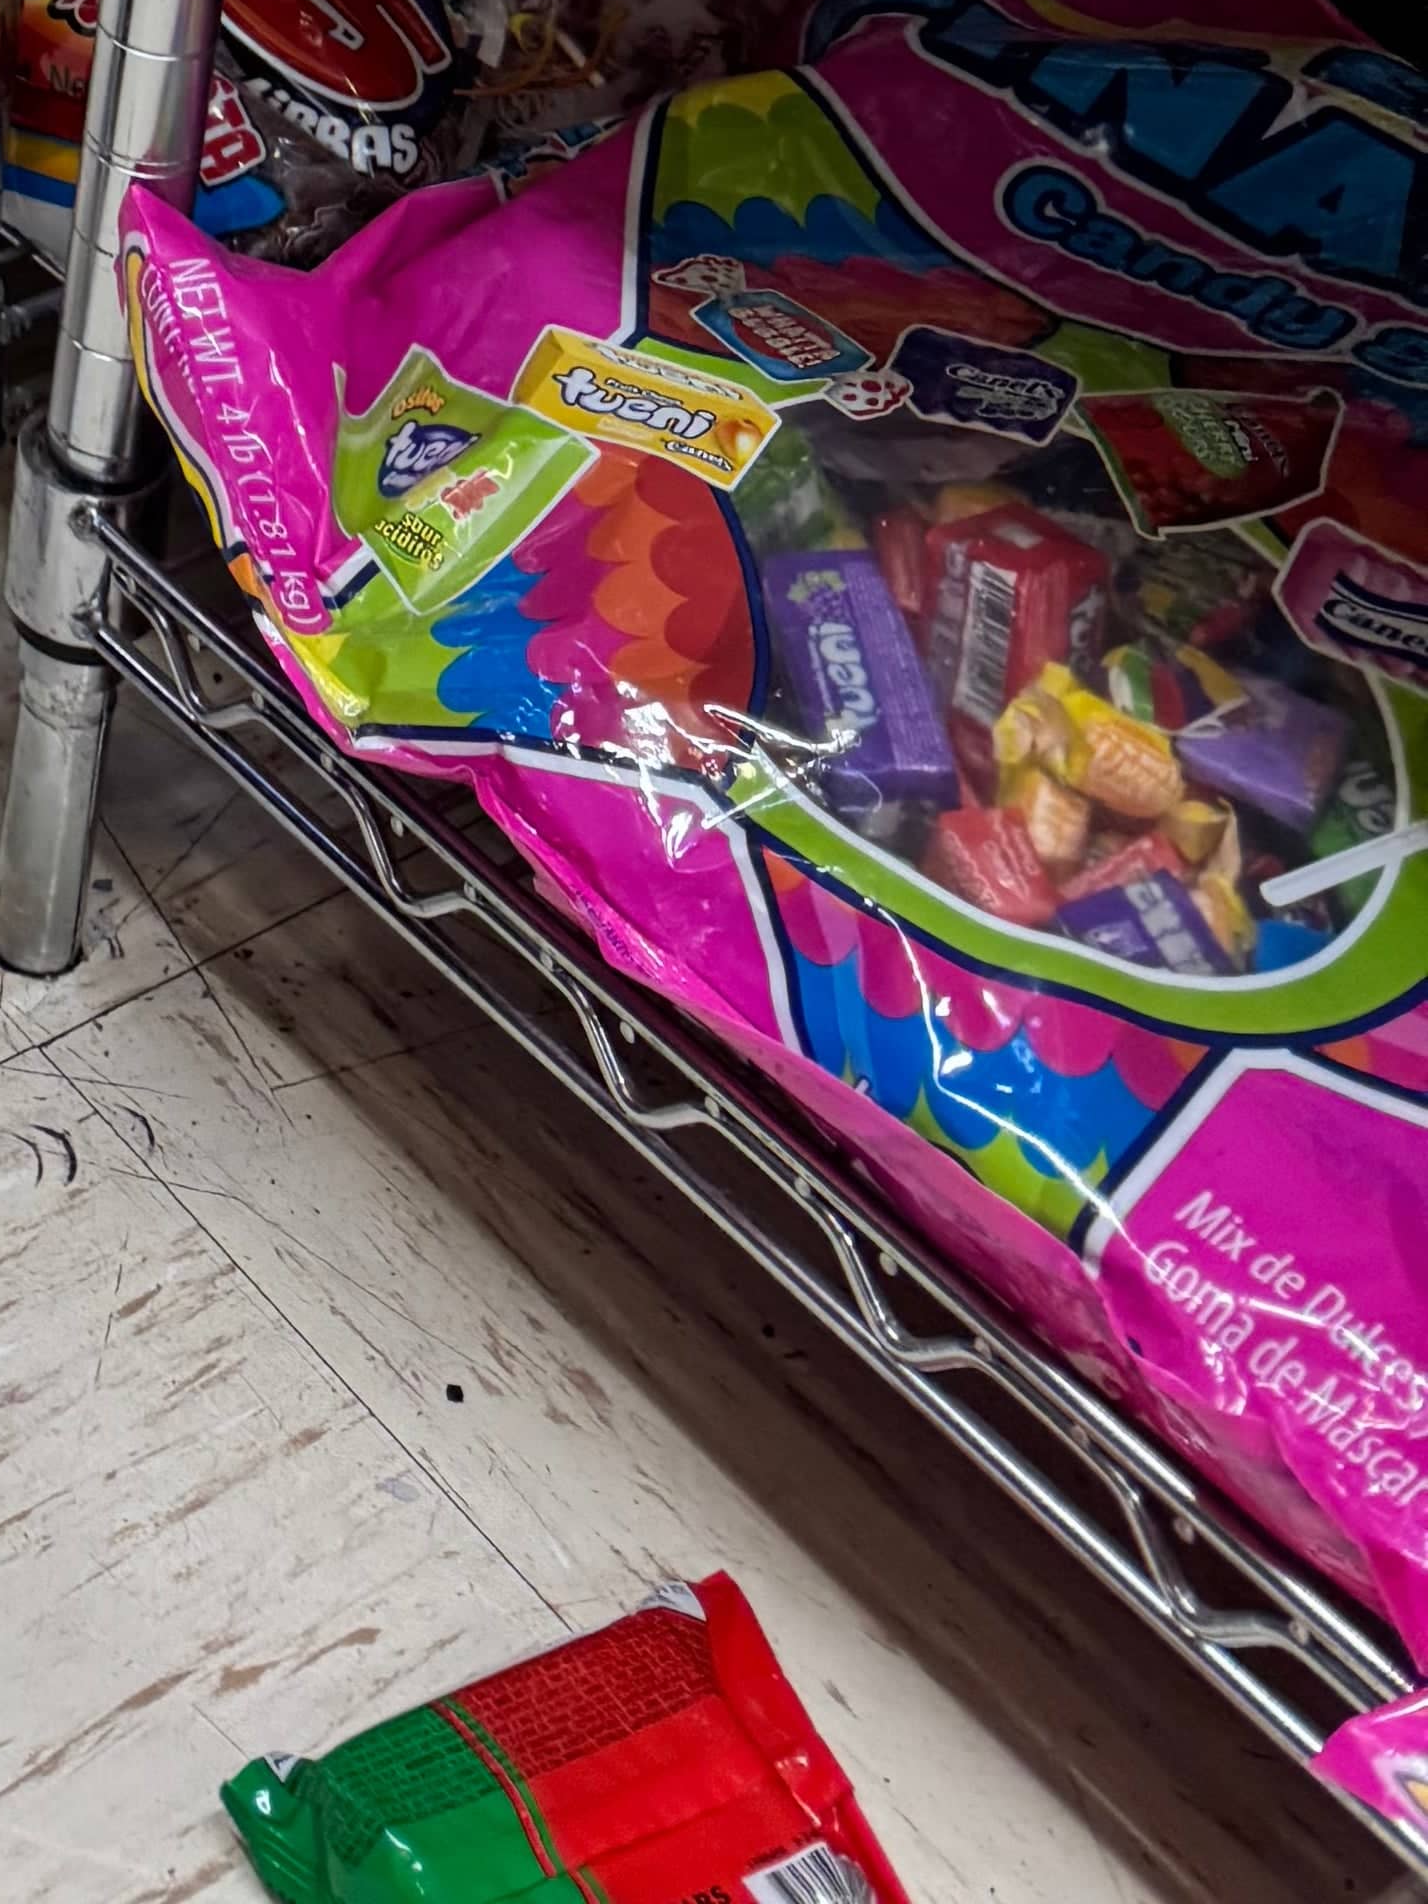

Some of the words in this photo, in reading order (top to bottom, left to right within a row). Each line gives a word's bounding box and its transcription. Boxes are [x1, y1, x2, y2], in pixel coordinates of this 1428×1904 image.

[168, 257, 222, 320] NET
[1001, 164, 1351, 354] Candy
[186, 312, 246, 396] WT.
[552, 366, 718, 440] tueni
[374, 519, 446, 572] ciditos
[400, 510, 442, 546] sour
[1176, 1192, 1254, 1264] Mix
[1252, 1248, 1309, 1300] de
[1144, 1239, 1254, 1348] Goma
[1249, 1340, 1309, 1392] de
